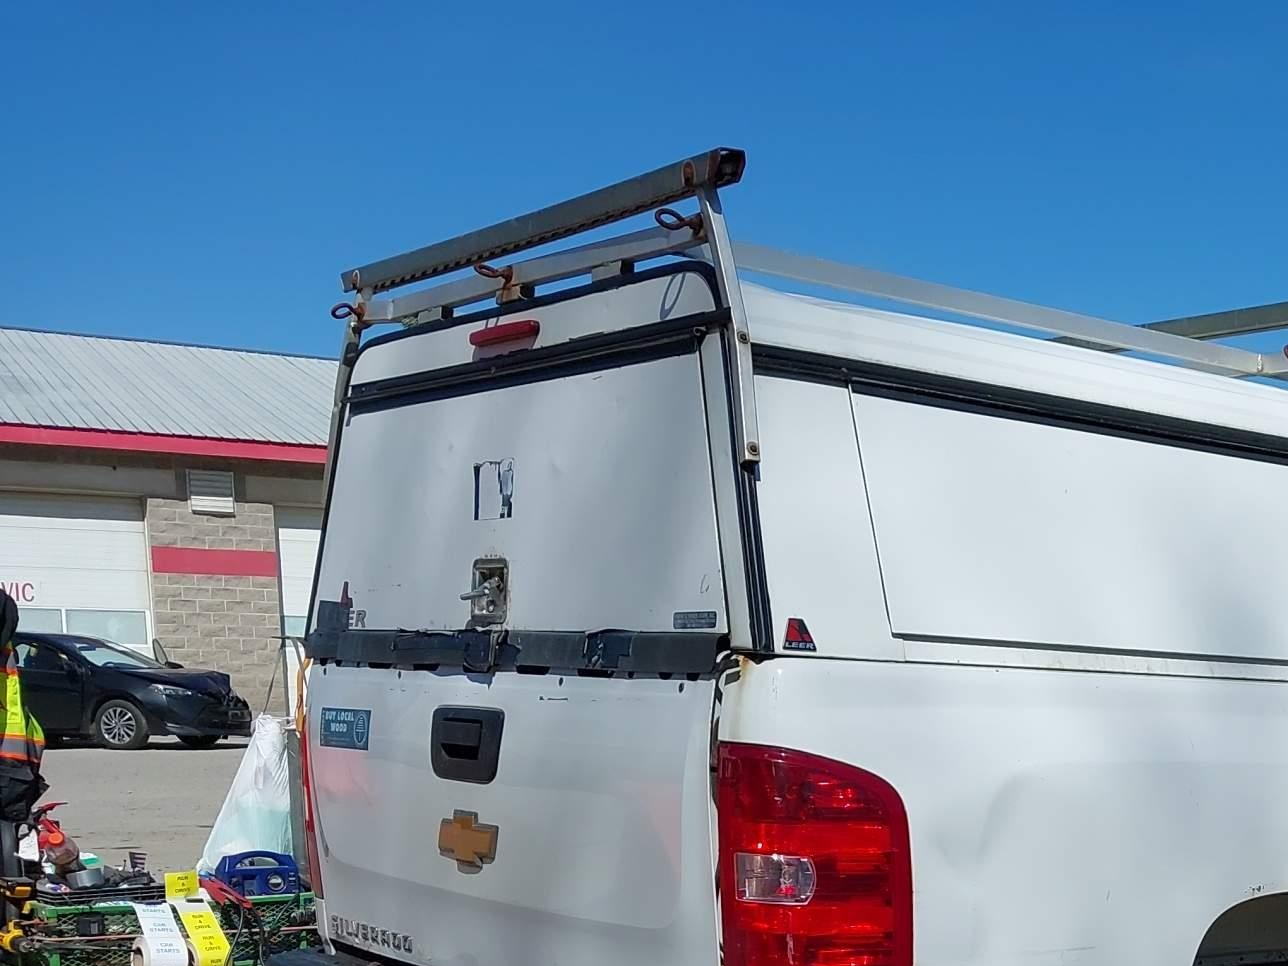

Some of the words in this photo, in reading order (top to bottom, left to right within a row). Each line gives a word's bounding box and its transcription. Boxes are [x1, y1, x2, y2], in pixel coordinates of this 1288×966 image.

[785, 641, 815, 650] LEER
[325, 710, 336, 721] BUY
[337, 711, 355, 722] LOCAL
[330, 722, 348, 733] WOOD
[330, 913, 414, 955] SILVERADO
